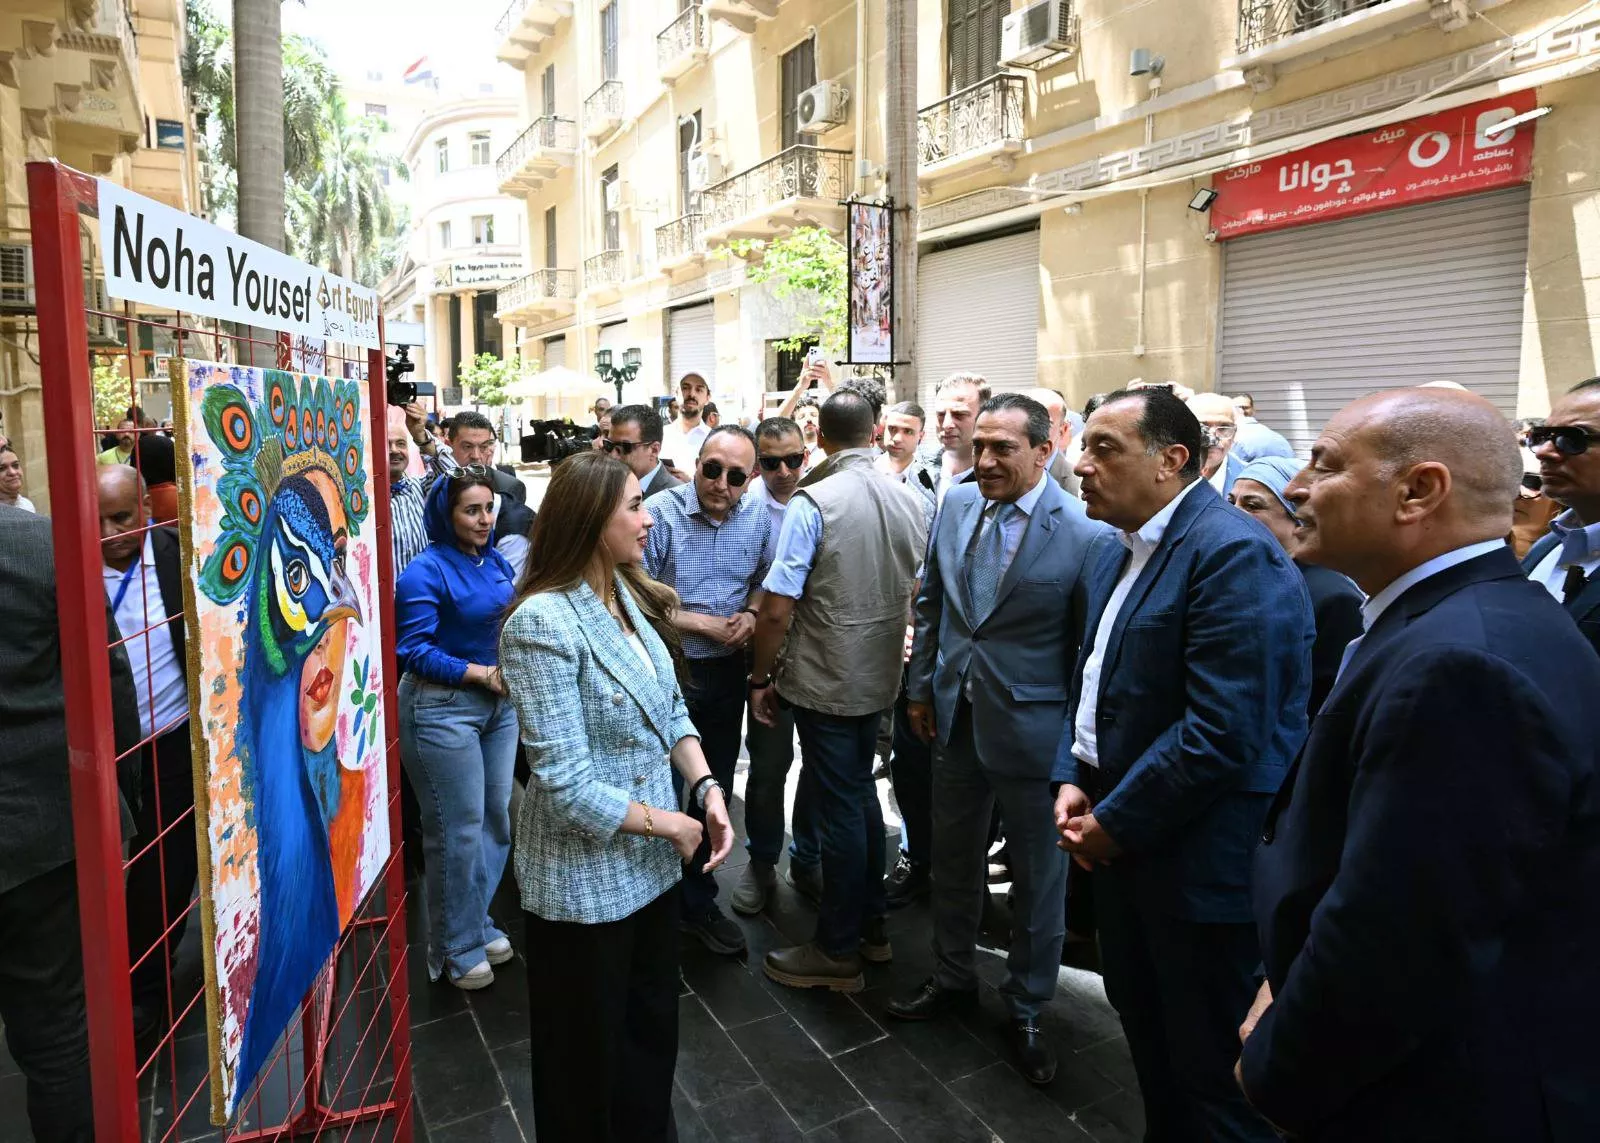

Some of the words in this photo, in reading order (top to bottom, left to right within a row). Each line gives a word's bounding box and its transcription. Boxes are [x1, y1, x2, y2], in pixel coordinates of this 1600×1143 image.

[114, 204, 215, 301] Noha
[317, 275, 343, 311] Art
[345, 286, 375, 325] Egypt
